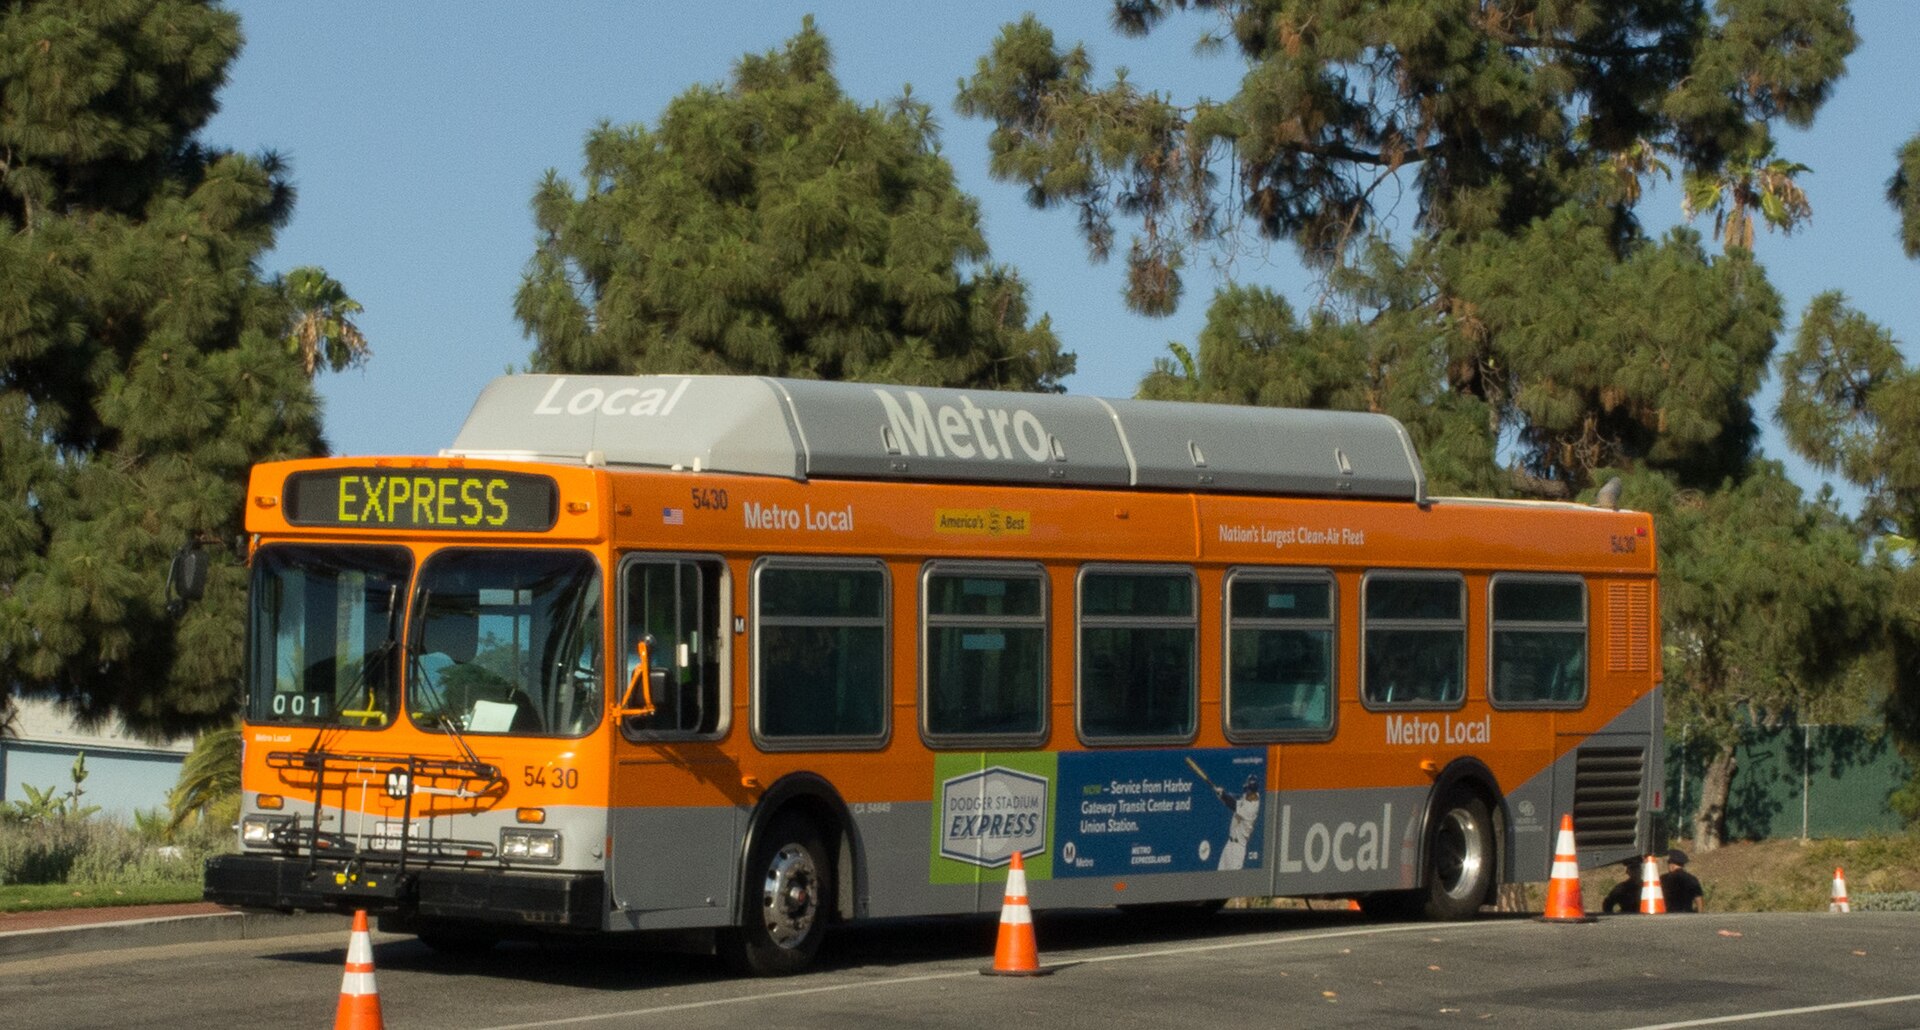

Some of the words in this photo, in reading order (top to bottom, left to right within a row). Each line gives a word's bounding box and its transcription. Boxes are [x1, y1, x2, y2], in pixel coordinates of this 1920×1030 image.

[533, 377, 693, 416] Local
[873, 389, 1050, 463] Metro
[338, 475, 510, 526] EXPRESS
[691, 488, 729, 510] 5430
[743, 501, 800, 530] Metro
[804, 503, 854, 532] Local
[939, 514, 985, 529] America's
[1005, 514, 1025, 531] Best
[1218, 523, 1259, 543] Nation's
[1261, 525, 1296, 549] Largest
[1297, 526, 1340, 545] Clean-Air
[1342, 527, 1365, 545] Fleet
[273, 694, 320, 717] 001
[1385, 714, 1441, 745] Metro
[1444, 714, 1491, 745] Local
[523, 765, 579, 790] 5430
[1110, 780, 1141, 795] Service
[1142, 779, 1161, 793] from
[1163, 777, 1192, 793] Harbor
[950, 796, 993, 812] DODGER
[995, 795, 1040, 810] STADIUM
[1081, 800, 1117, 817] Gateway
[1118, 798, 1146, 813] Transit
[1147, 798, 1174, 813] Center
[1175, 796, 1192, 811] and
[949, 812, 1040, 839] EXPRESS
[1080, 819, 1106, 834] Union
[1107, 818, 1139, 832] Station.
[1279, 802, 1392, 873] Local
[1131, 846, 1152, 855] METRO
[1075, 858, 1094, 868] Metro
